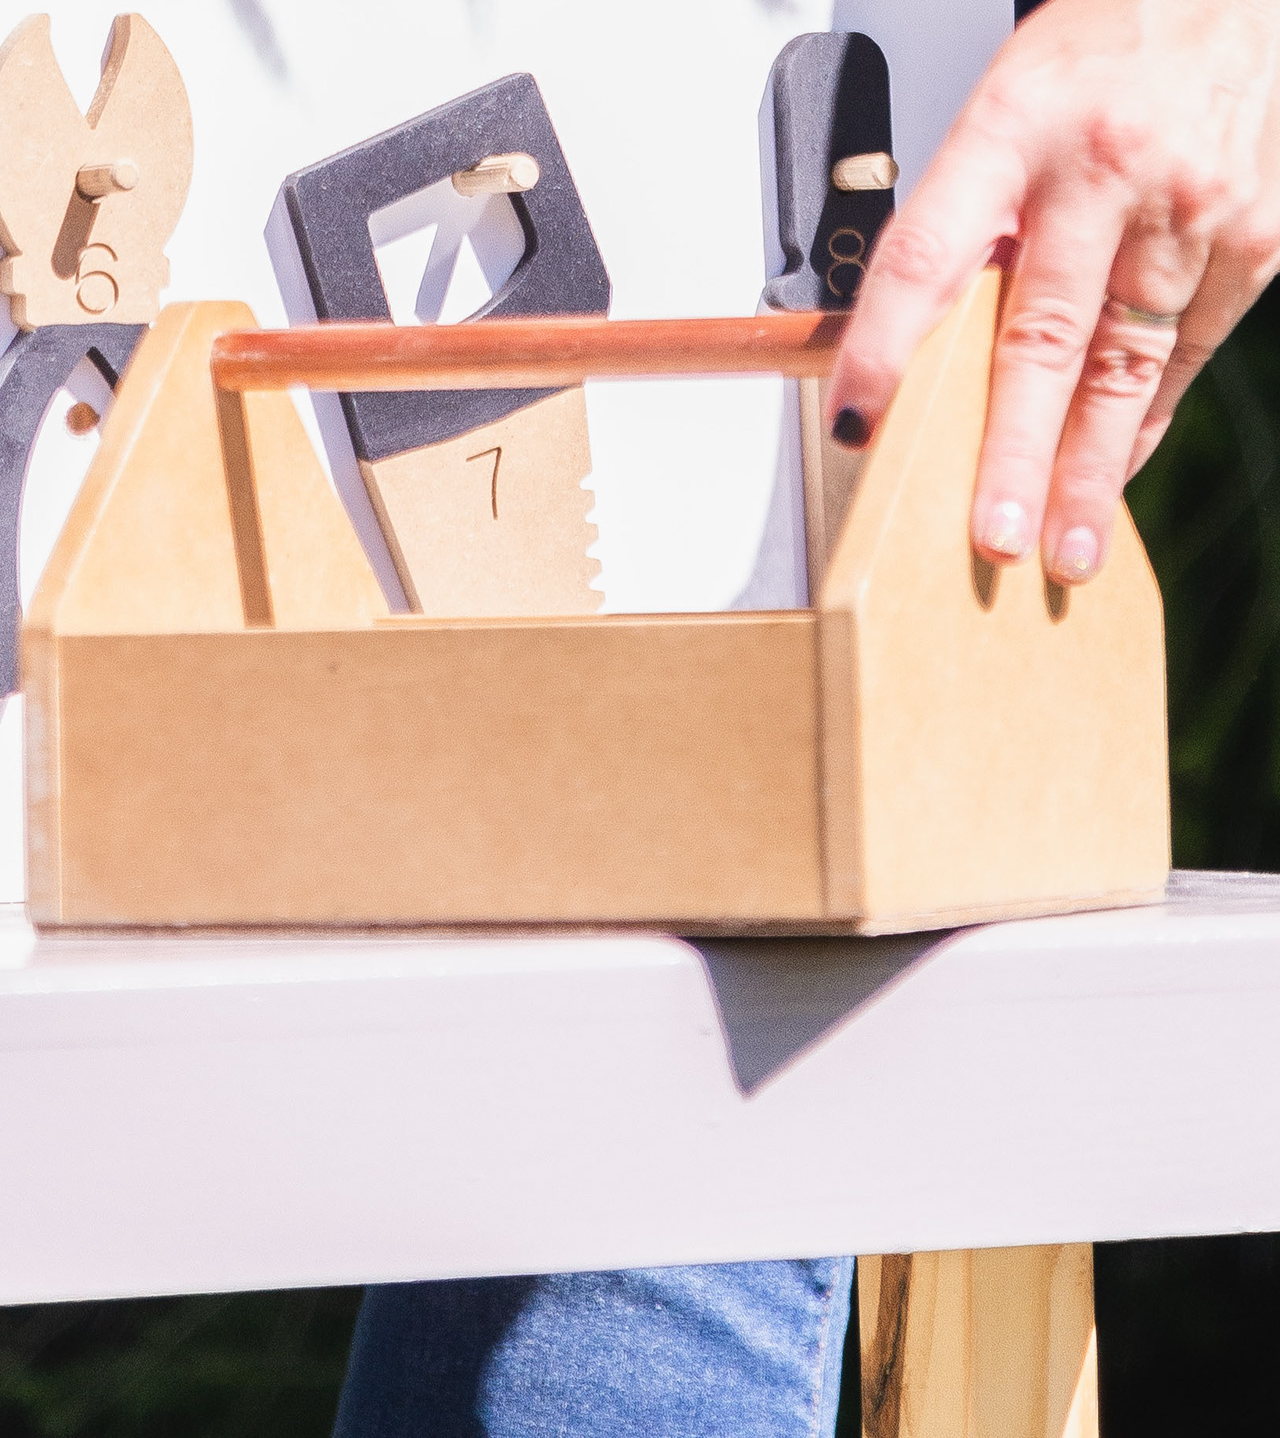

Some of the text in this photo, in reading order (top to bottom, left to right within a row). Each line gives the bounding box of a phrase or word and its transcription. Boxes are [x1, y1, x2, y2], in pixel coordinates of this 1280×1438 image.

[73, 242, 120, 315] 6
[827, 227, 868, 297] 8
[466, 445, 503, 521] 7
